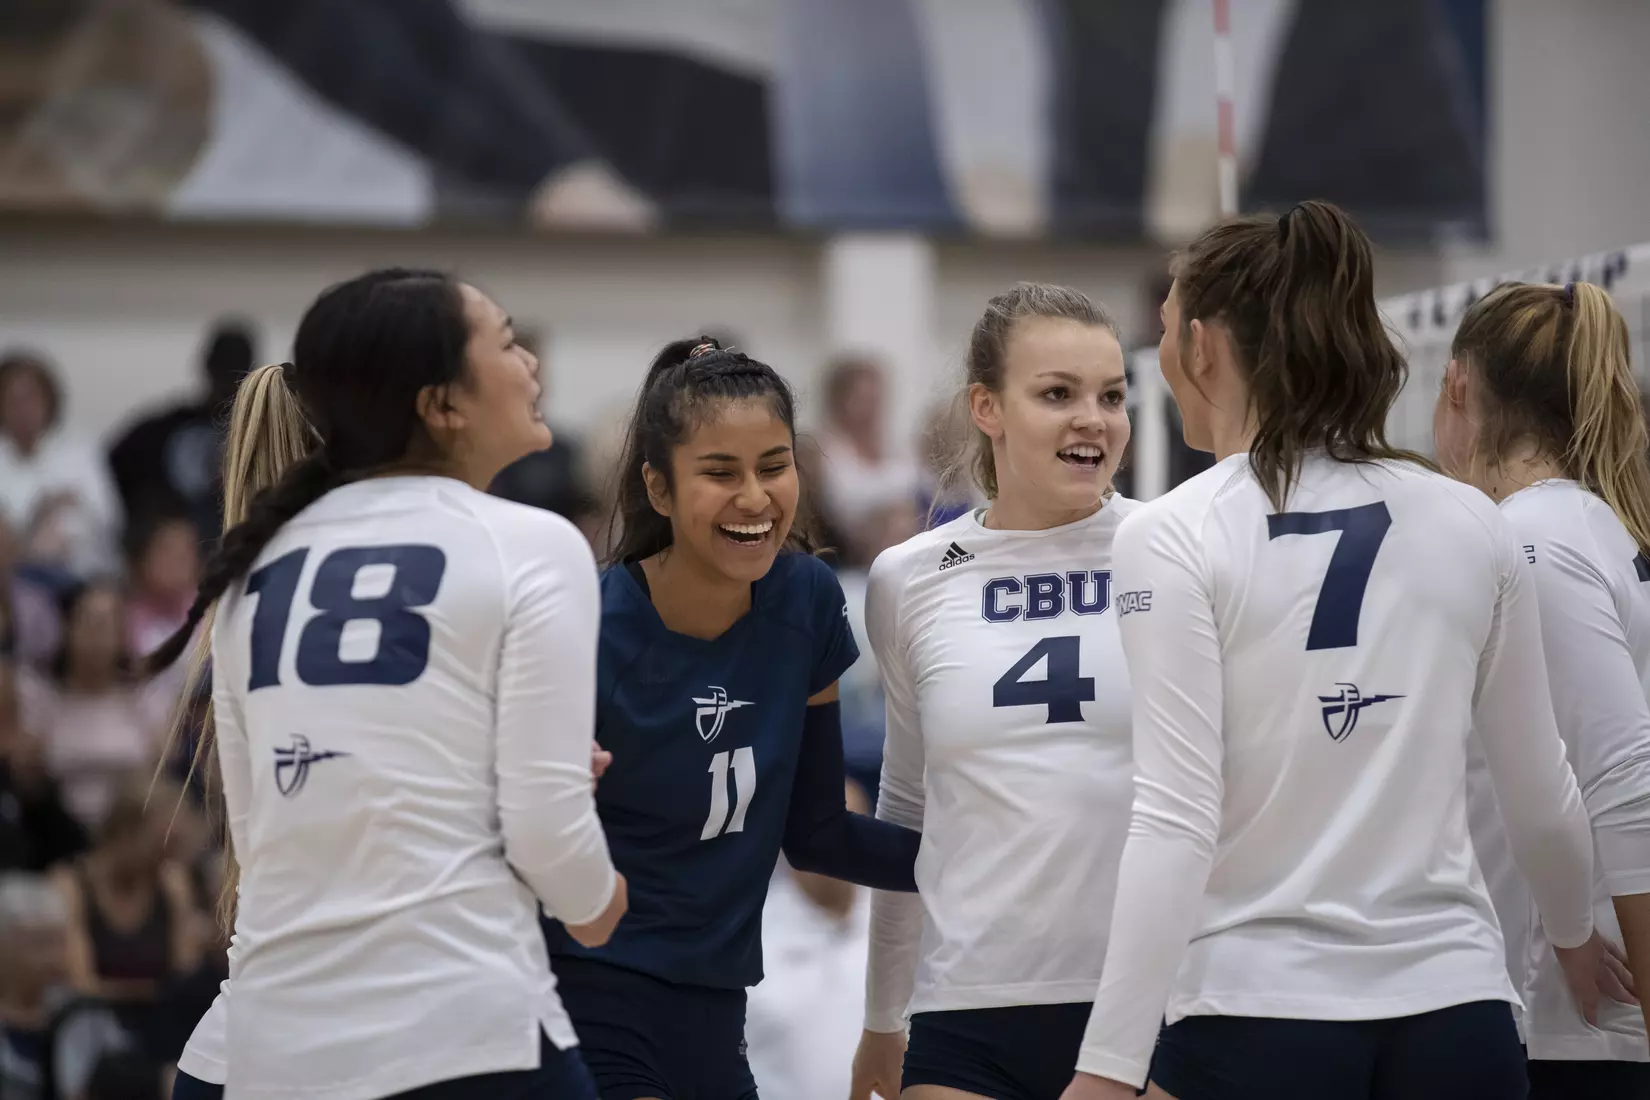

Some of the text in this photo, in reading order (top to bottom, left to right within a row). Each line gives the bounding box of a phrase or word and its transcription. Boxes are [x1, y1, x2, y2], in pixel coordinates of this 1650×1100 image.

[938, 553, 976, 571] adidas
[981, 569, 1112, 624] CBU
[1266, 501, 1393, 651] 7
[245, 543, 447, 693] 18
[992, 635, 1096, 724] 4
[700, 746, 757, 841] 11
